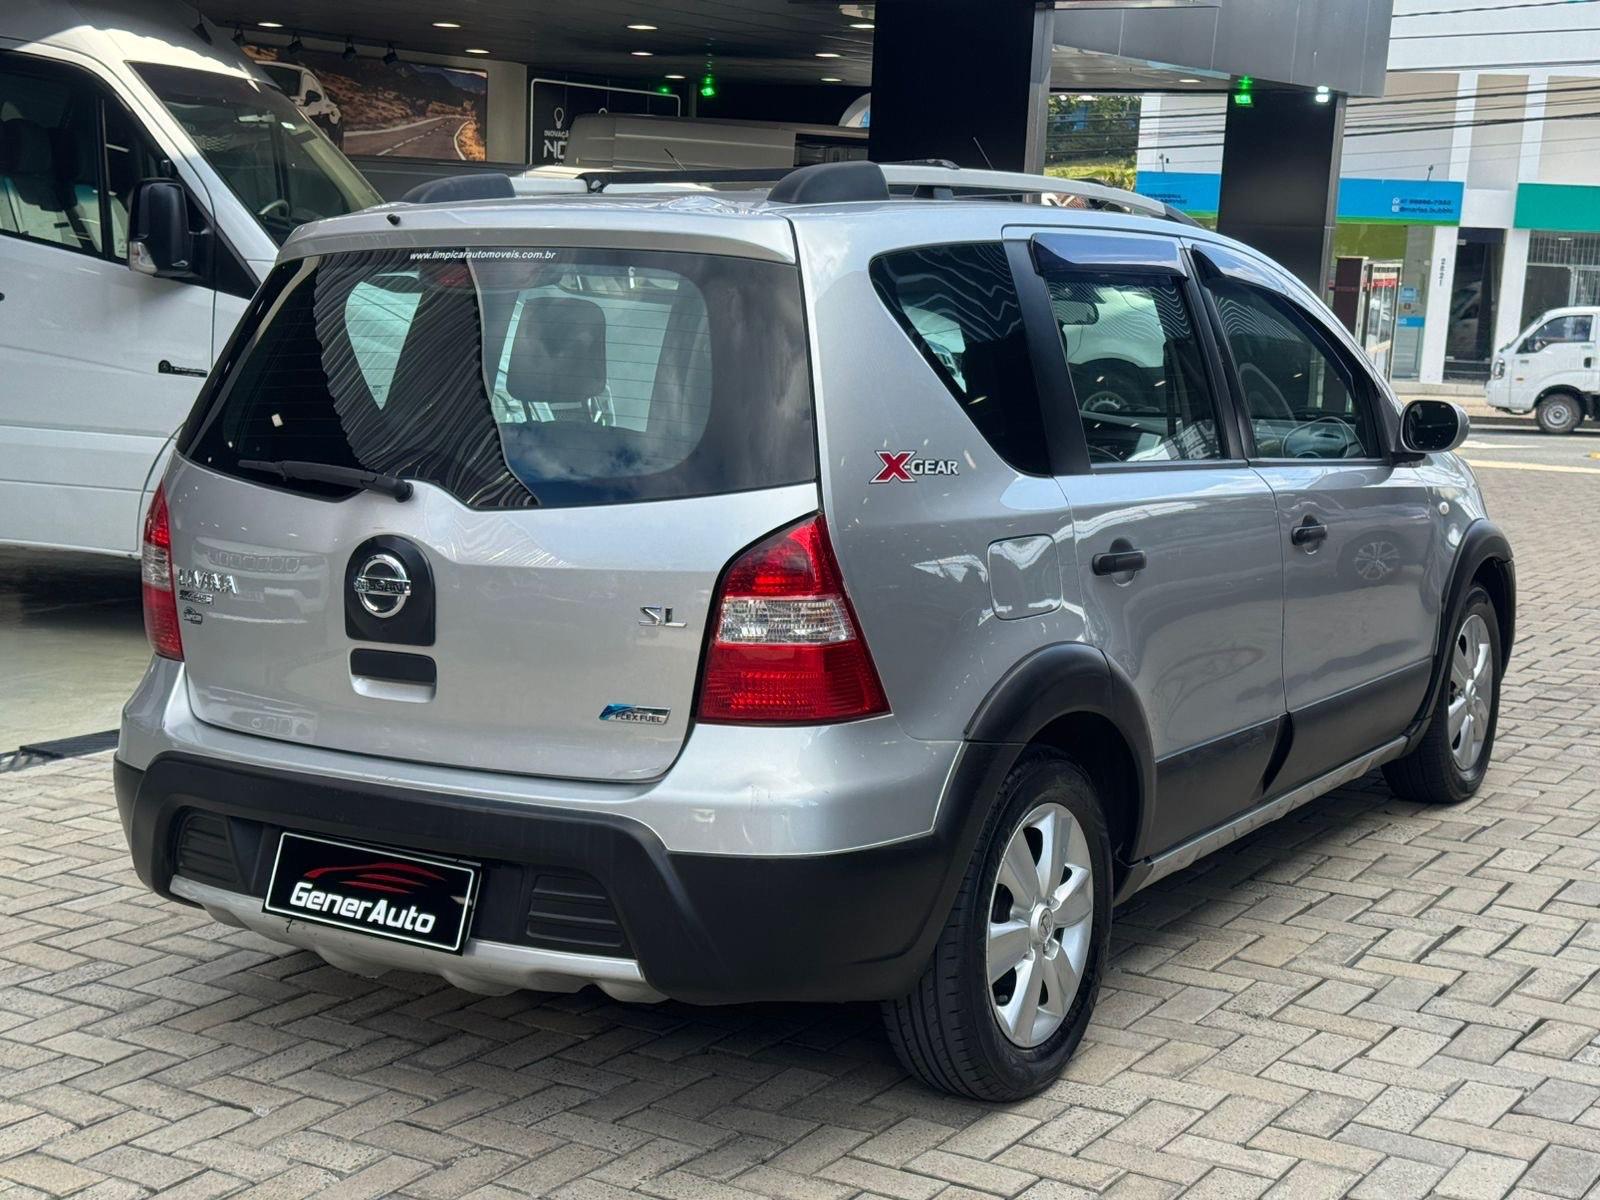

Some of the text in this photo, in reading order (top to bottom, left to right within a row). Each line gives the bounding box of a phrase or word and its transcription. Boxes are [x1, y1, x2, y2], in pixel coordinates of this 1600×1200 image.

[409, 249, 556, 261] www.limpicarautomoveis.com.br
[869, 450, 960, 484] X-GEAR
[638, 606, 688, 628] SL
[615, 713, 663, 723] FLEX FUEL
[289, 881, 436, 934] GenerAuto
